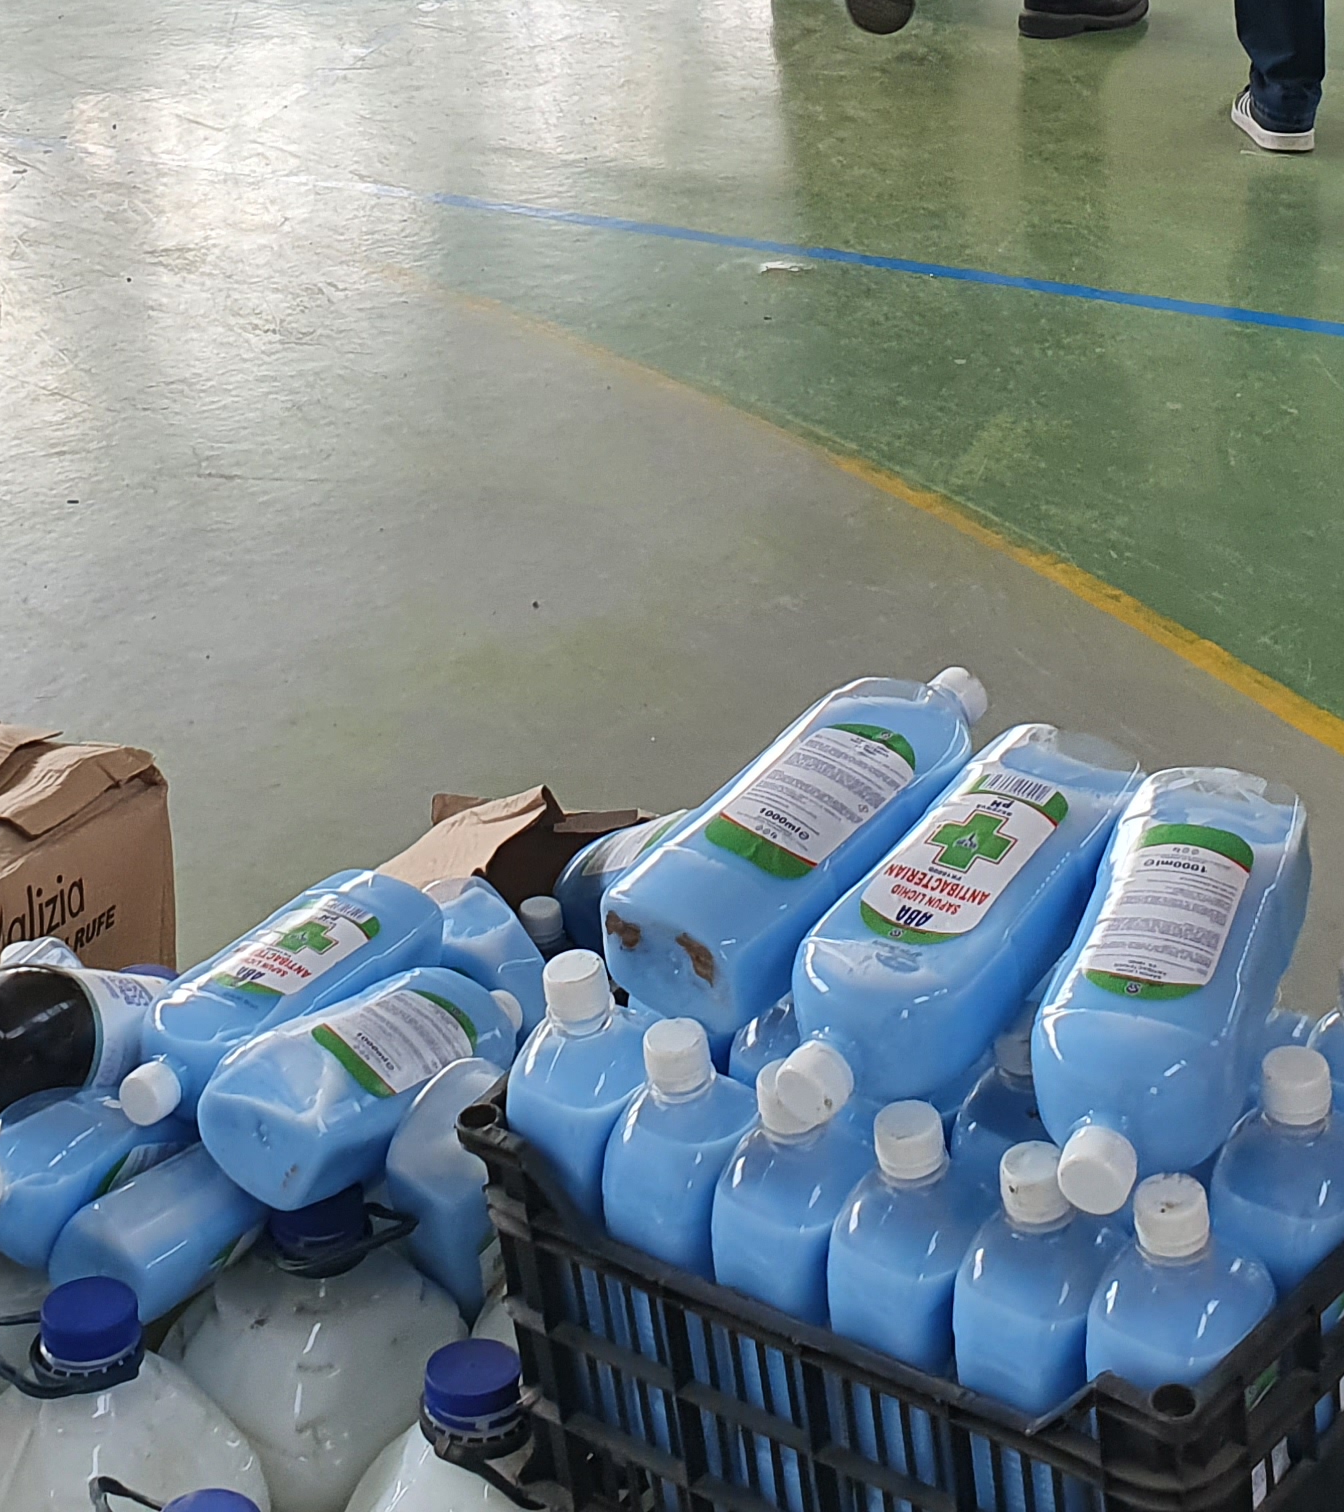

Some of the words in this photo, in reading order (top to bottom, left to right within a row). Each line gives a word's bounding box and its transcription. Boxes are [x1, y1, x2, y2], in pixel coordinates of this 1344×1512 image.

[1156, 859, 1208, 873] 1000ml
[884, 864, 990, 905] ANTIBACTERIAN
[890, 884, 926, 904] LICHID
[895, 904, 934, 927] ABA
[924, 896, 961, 915] SAPUN
